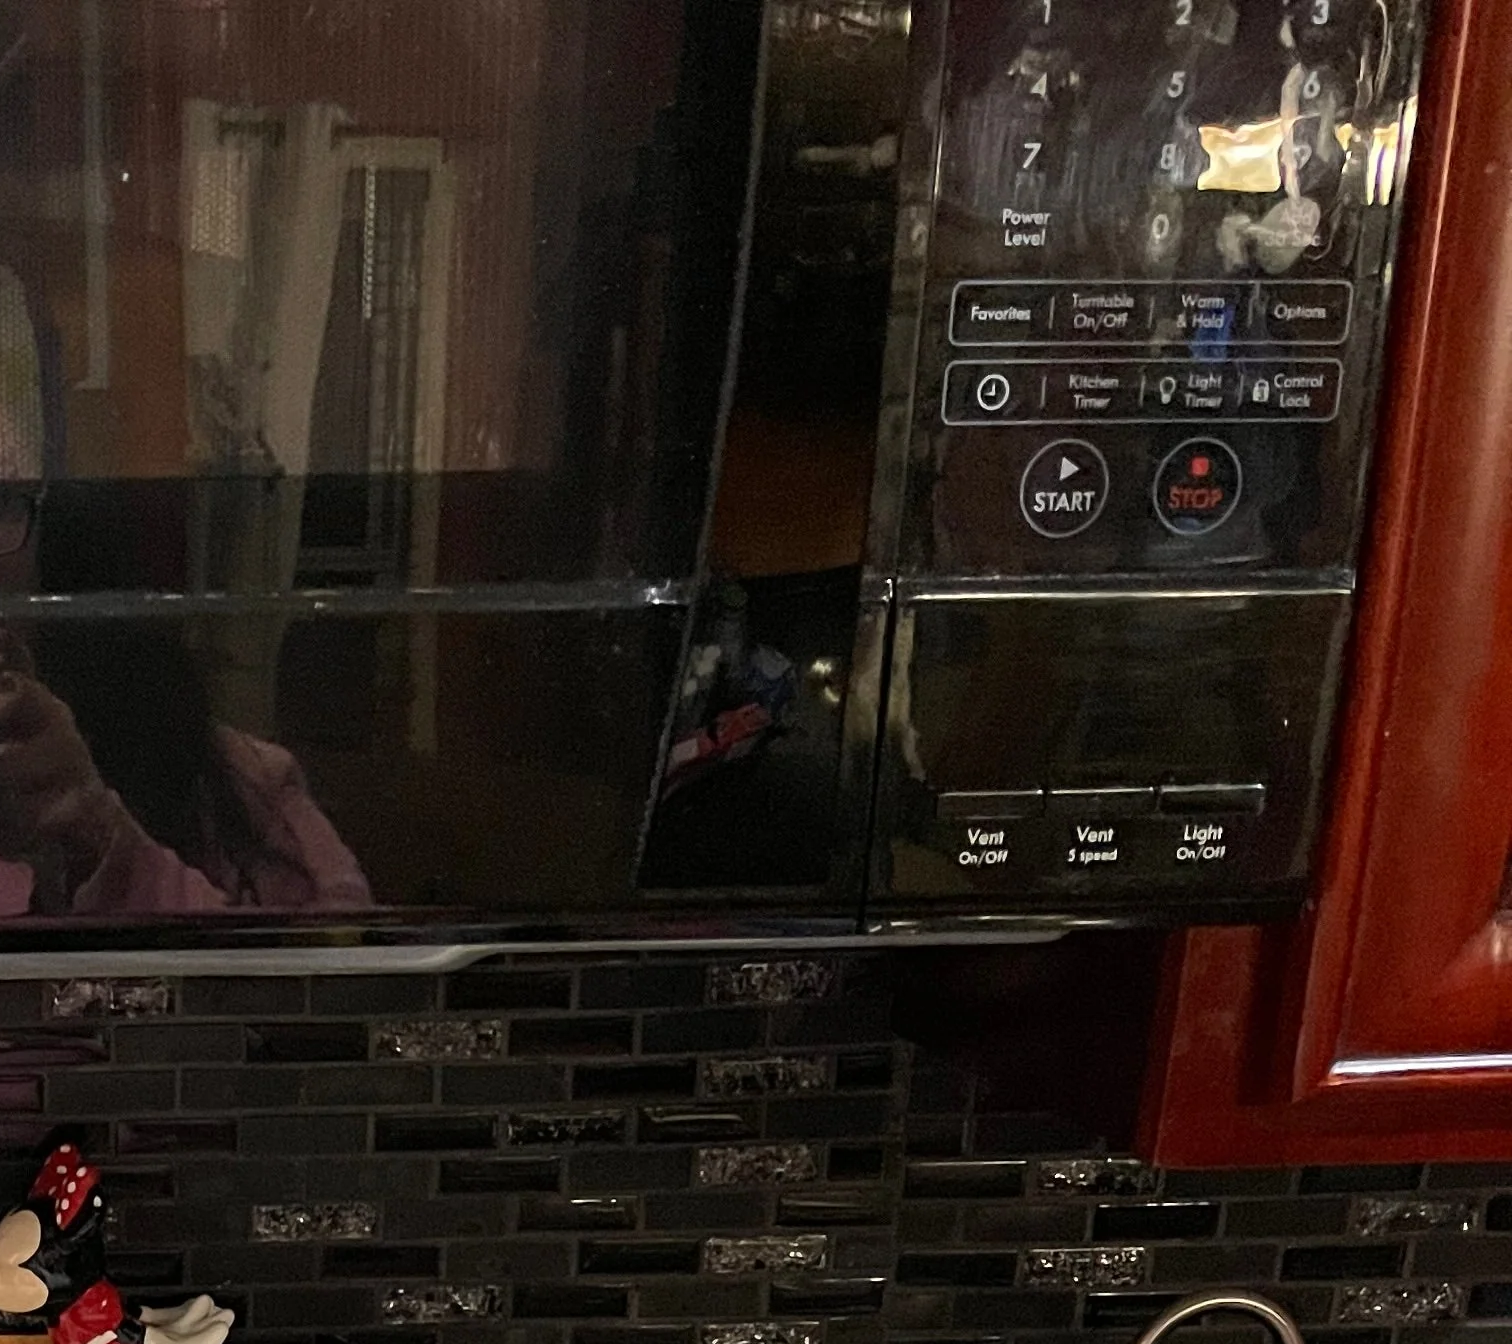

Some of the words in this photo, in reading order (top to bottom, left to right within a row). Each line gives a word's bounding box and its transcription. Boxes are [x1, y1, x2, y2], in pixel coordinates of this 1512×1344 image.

[1175, 0, 1189, 25] 2
[1311, 0, 1330, 25] 3
[1029, 72, 1049, 100] 4
[1166, 71, 1186, 99] 5
[1302, 71, 1321, 98] 6
[1023, 142, 1042, 169] 7
[1160, 143, 1176, 170] 8
[1002, 208, 1051, 226] Power
[1151, 213, 1169, 239] 0
[1004, 228, 1046, 247] Level
[1072, 293, 1135, 309] Turntable
[1181, 294, 1225, 309] Warm
[971, 306, 1031, 321] Favorites
[1176, 314, 1186, 329] &
[1192, 313, 1225, 329] Hold
[1274, 304, 1327, 323] Options
[1073, 312, 1128, 334] On/Off
[1069, 374, 1119, 390] Kitchen
[1188, 374, 1222, 393] Light
[1274, 373, 1323, 389] Control
[1073, 395, 1111, 409] Timer
[1184, 394, 1223, 409] Timer
[1278, 392, 1310, 408] Lock
[1033, 491, 1096, 513] START
[1168, 485, 1224, 510] STOP
[967, 828, 1005, 845] Vent
[1076, 825, 1114, 842] Vent
[1184, 824, 1223, 845] Light
[958, 849, 1008, 867] On/Off
[1080, 848, 1118, 865] speed
[1176, 845, 1226, 862] On/Off
